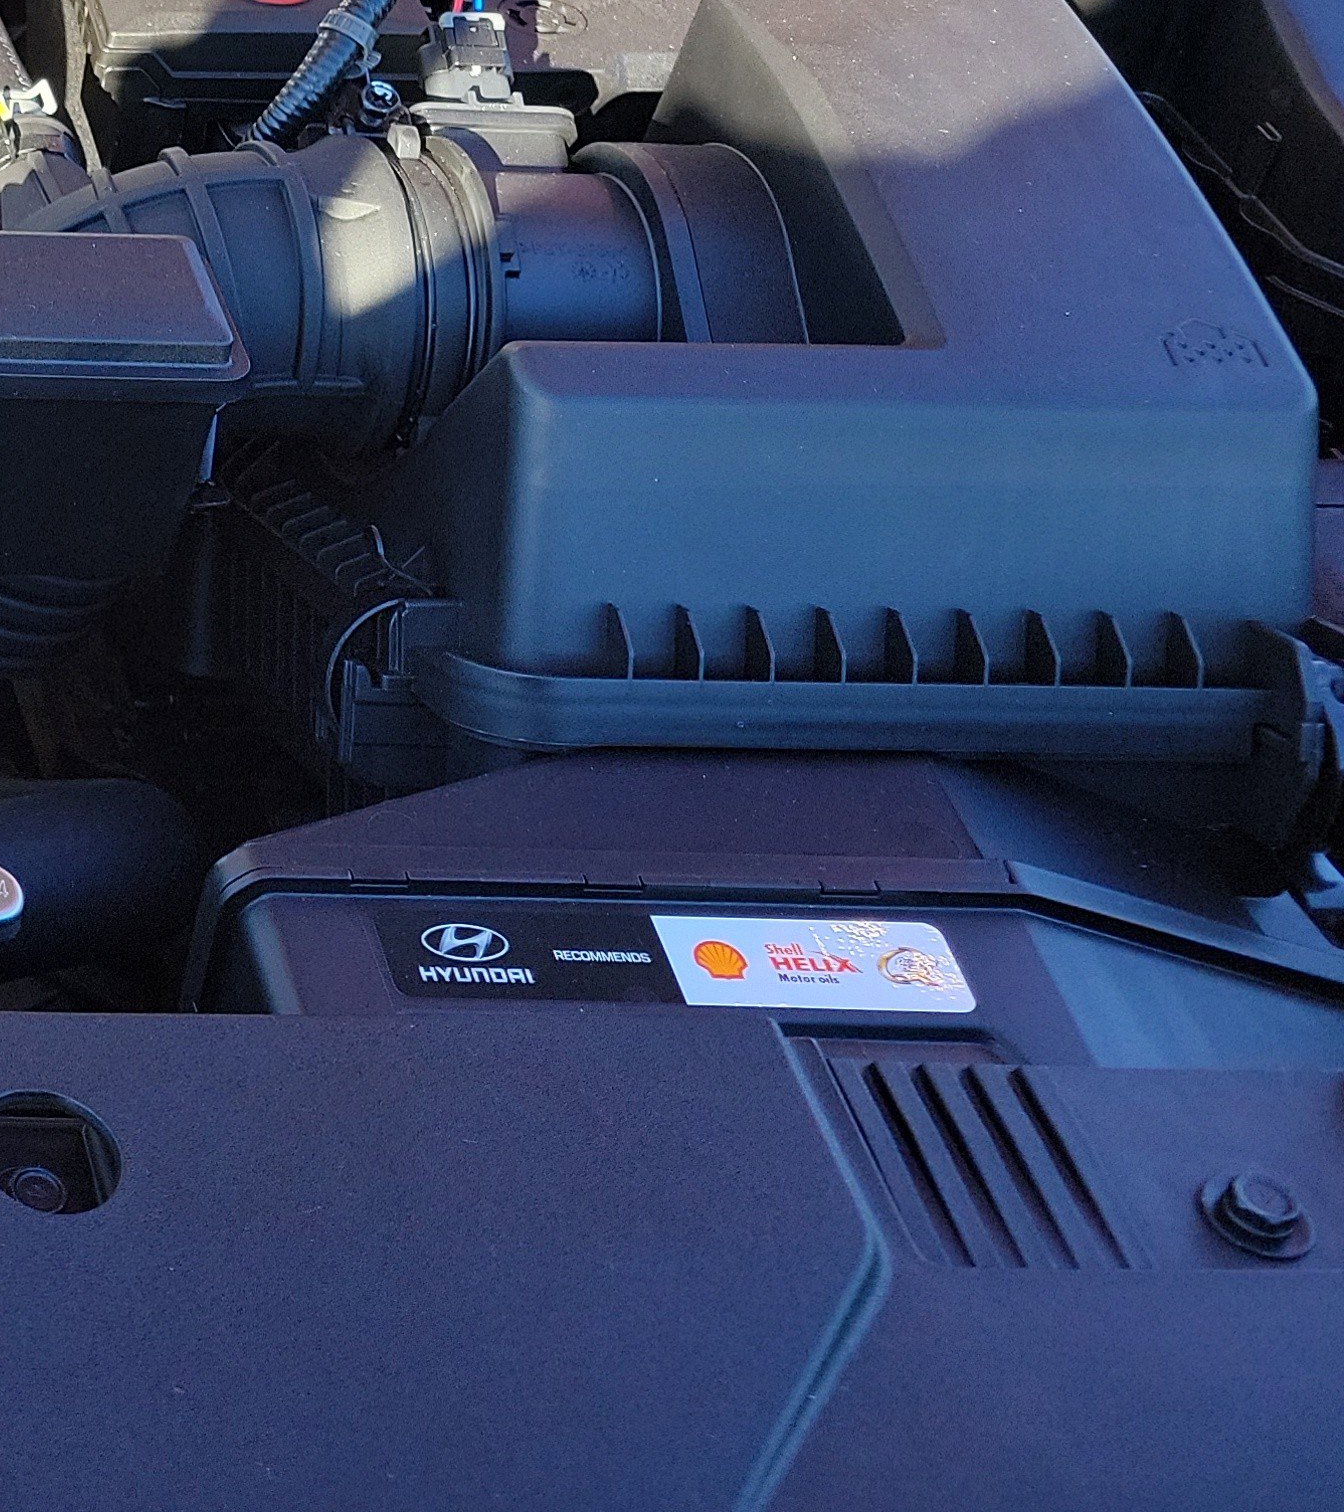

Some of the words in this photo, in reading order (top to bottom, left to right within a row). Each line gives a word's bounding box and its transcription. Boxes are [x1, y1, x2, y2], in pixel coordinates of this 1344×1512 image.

[764, 942, 804, 956] Shell
[418, 965, 536, 984] HYUNDAI
[553, 949, 652, 964] RECOMMENDS
[769, 955, 860, 973] HELIX
[778, 972, 816, 984] Motor
[818, 974, 840, 985] oils
